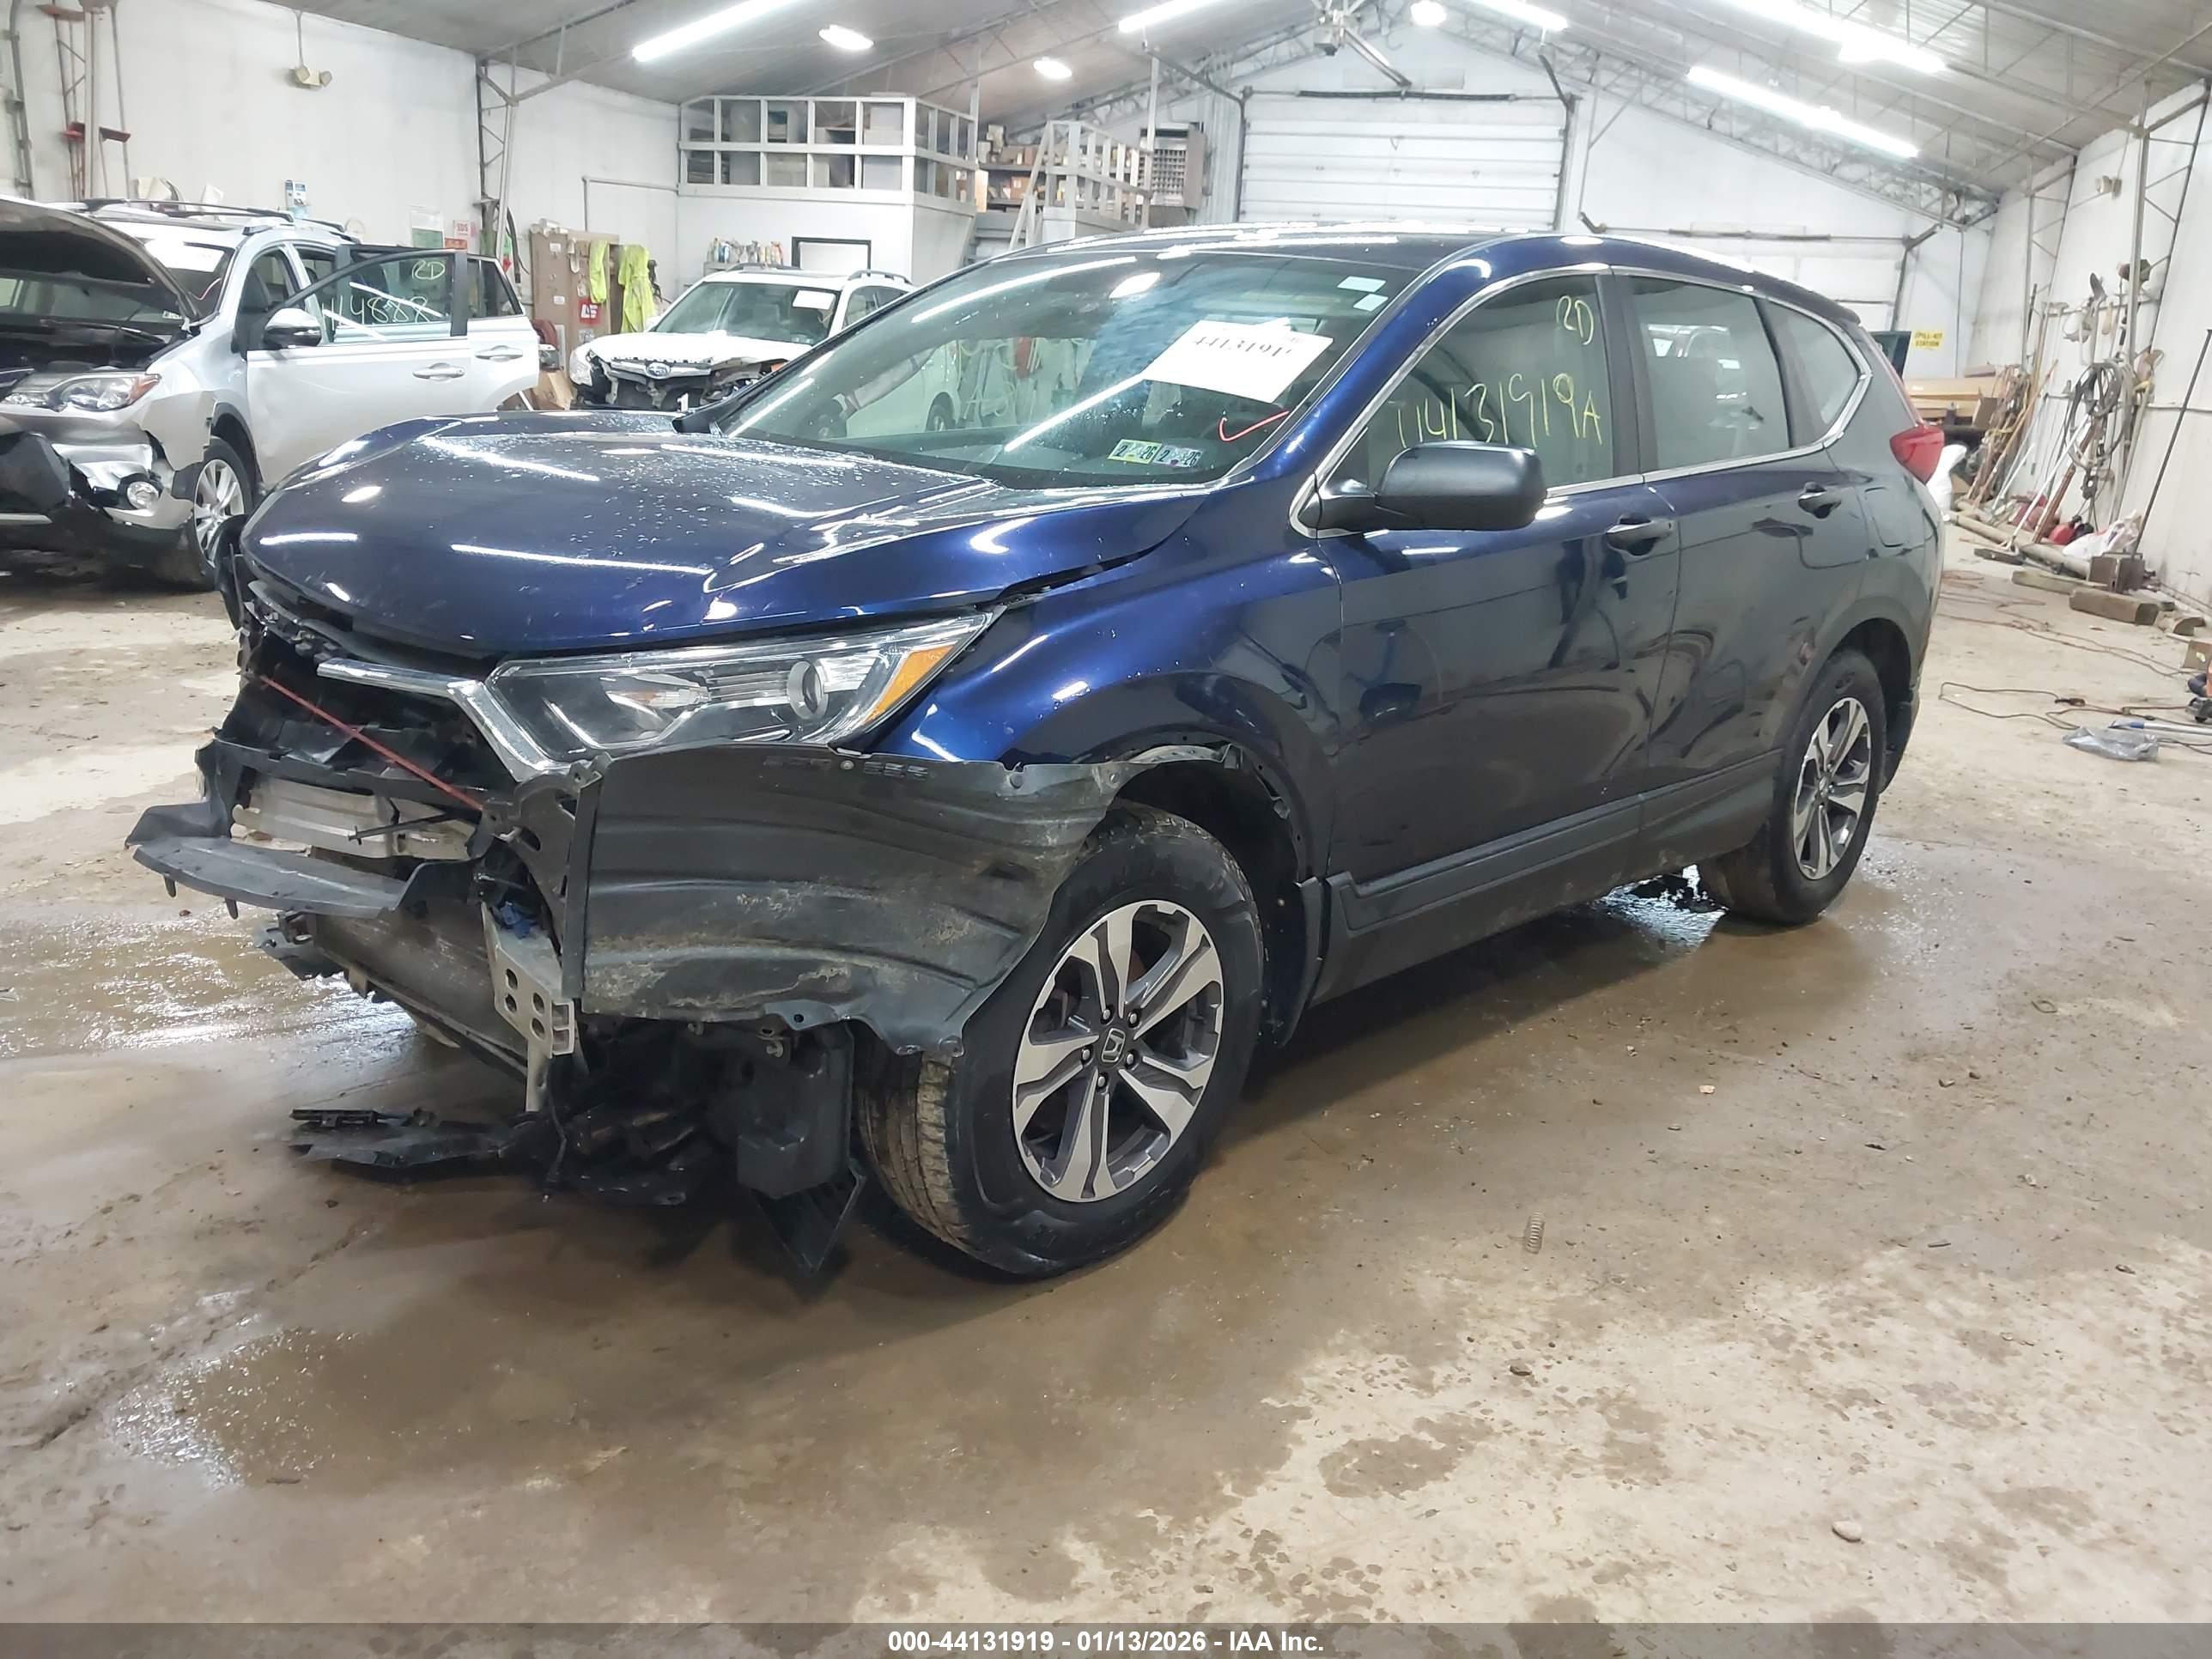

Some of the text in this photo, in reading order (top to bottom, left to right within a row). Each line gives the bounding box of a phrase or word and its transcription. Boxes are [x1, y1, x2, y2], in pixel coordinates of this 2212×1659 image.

[1115, 444, 1158, 460] 2 26
[1156, 448, 1202, 467] 2 26
